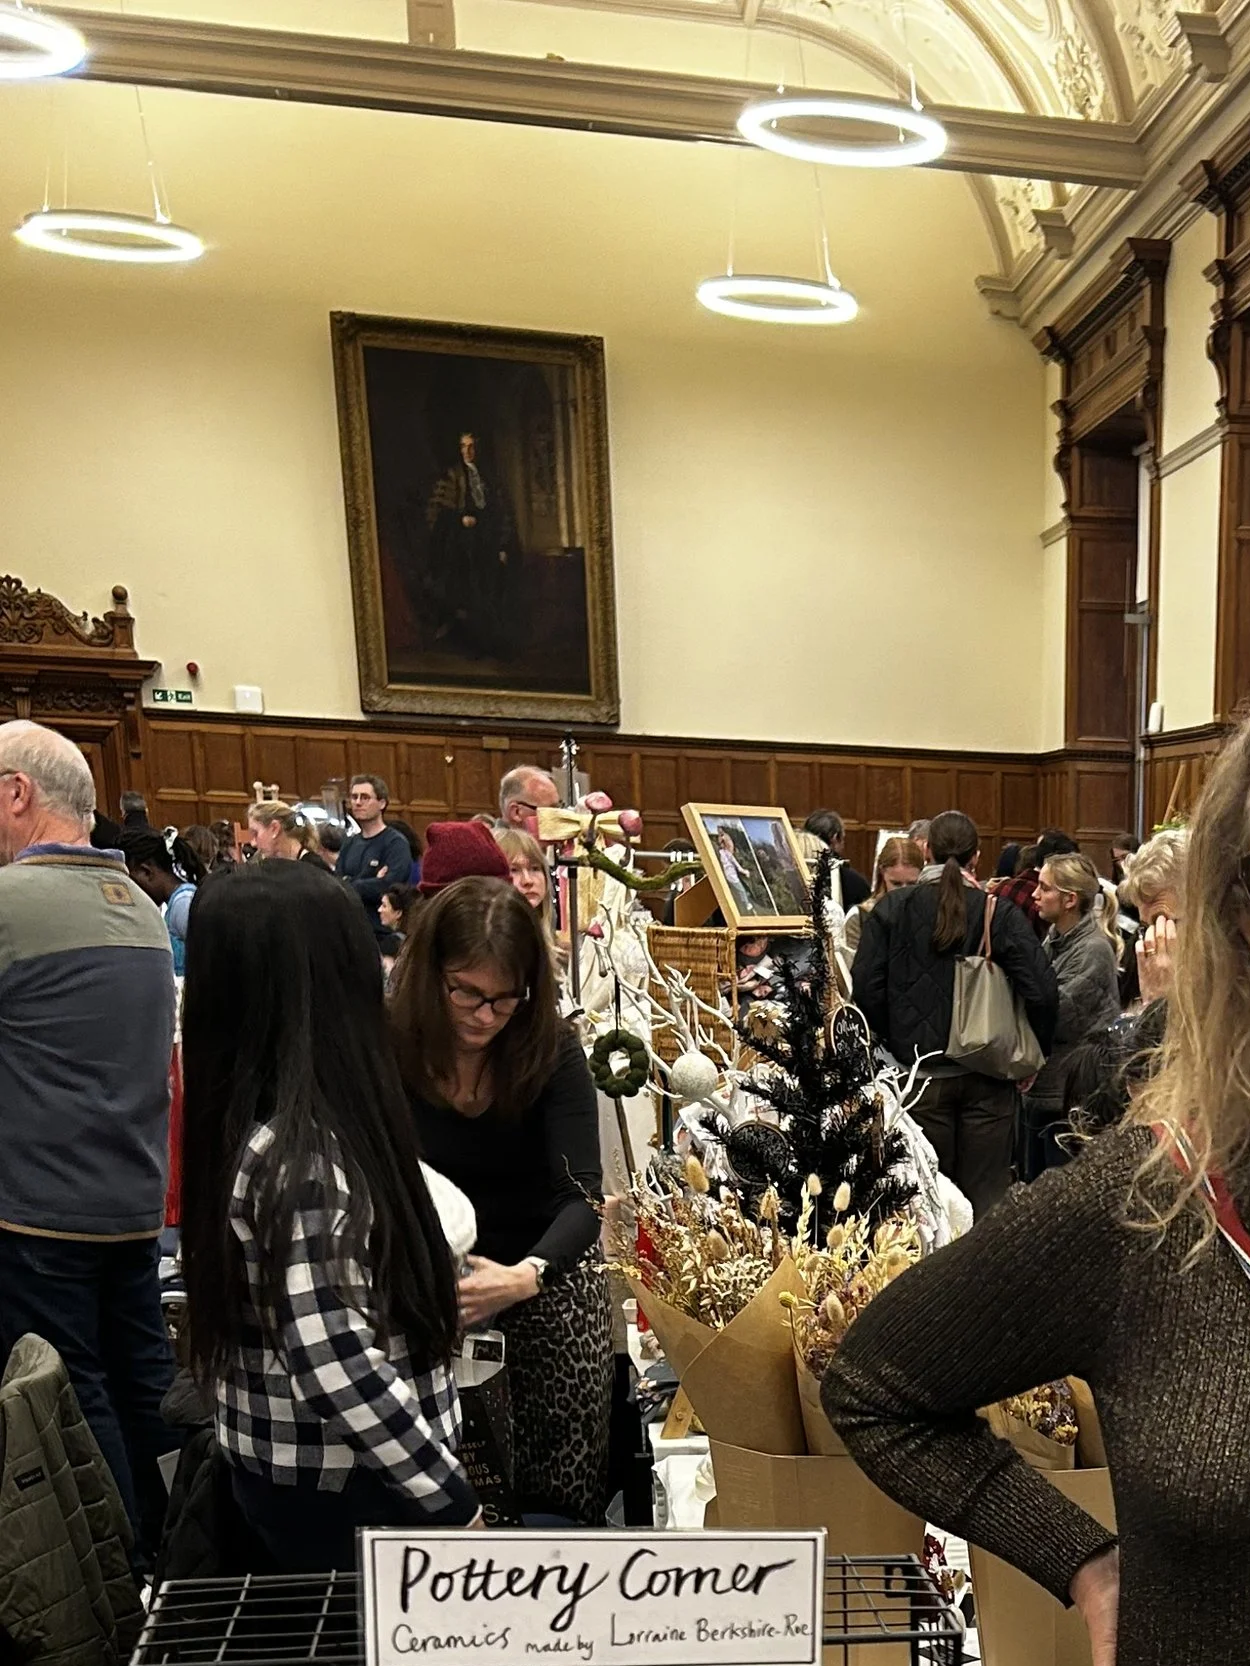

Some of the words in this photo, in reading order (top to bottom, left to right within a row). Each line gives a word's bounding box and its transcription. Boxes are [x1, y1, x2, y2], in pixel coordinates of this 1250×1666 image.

[401, 1545, 610, 1633] Pottery
[619, 1548, 797, 1600] Corner
[392, 1623, 512, 1653] Ceramics
[525, 1639, 574, 1653] made
[576, 1635, 594, 1660] by
[611, 1613, 688, 1647] Lorraine
[696, 1613, 811, 1643] Berkshire-Roe
